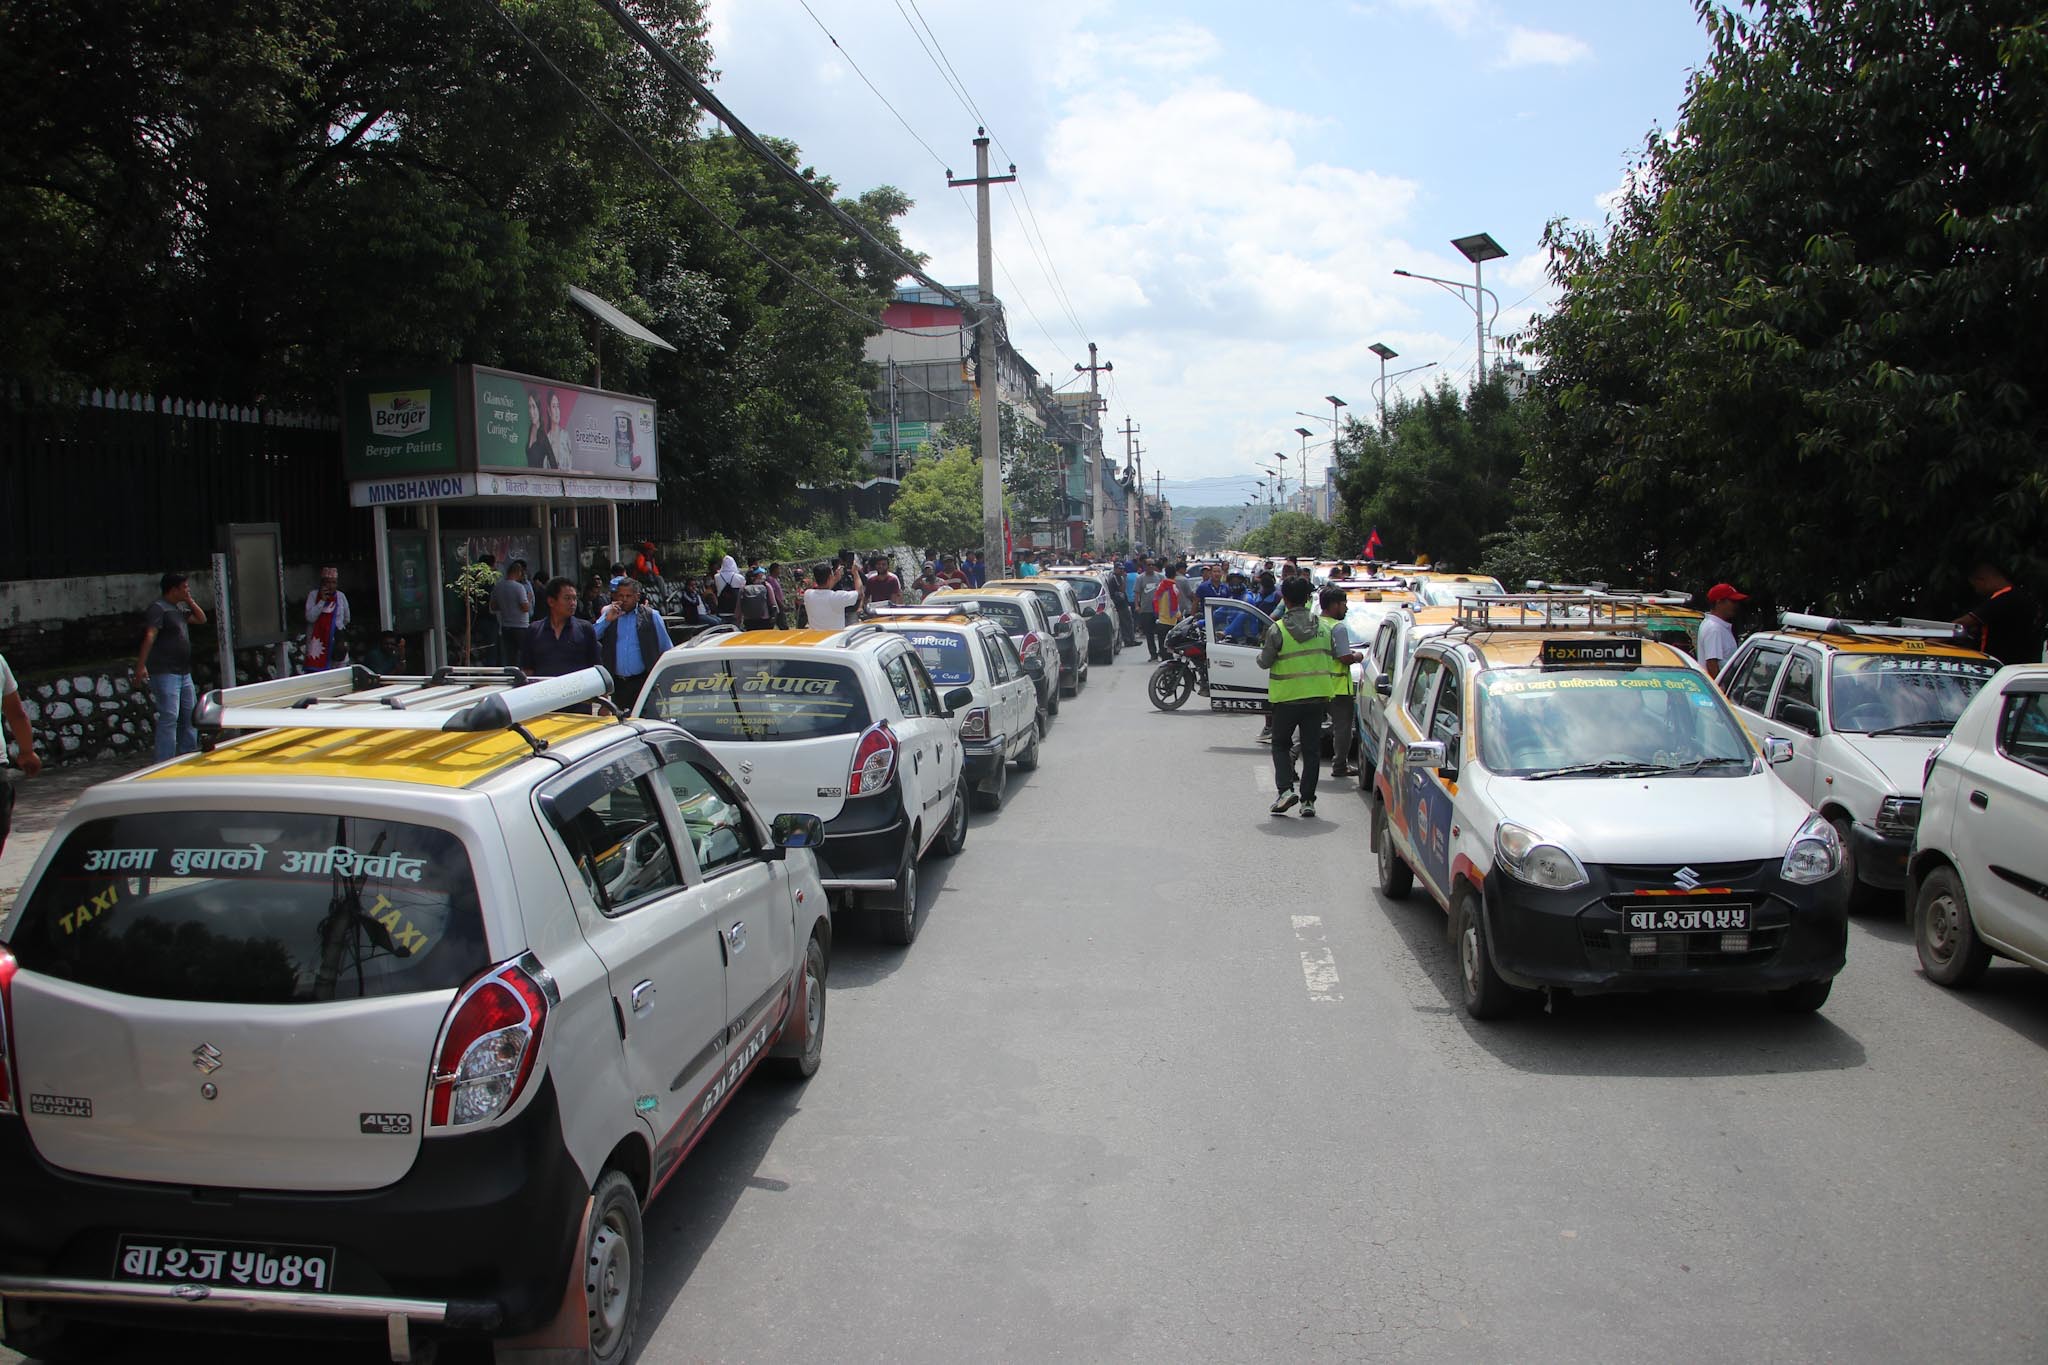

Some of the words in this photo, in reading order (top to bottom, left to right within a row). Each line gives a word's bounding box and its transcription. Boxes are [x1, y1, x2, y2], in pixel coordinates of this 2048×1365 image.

[376, 410, 426, 429] Berger
[487, 421, 508, 439] Caring
[366, 445, 402, 457] Berger
[406, 442, 442, 453] Paints
[369, 478, 463, 503] MINBHAWON
[1548, 645, 1636, 658] taximandu
[742, 671, 839, 694] नेपाल
[84, 848, 158, 871] आमा
[169, 844, 268, 875] बुबाको
[280, 846, 427, 882] आशिर्वाद
[58, 884, 119, 936] TAXI
[369, 894, 429, 954] TAXI
[32, 1095, 91, 1107] MARUTI
[32, 1104, 91, 1116] SUZUKI
[363, 1115, 410, 1125] ALTO
[382, 1125, 410, 1133] 800
[123, 1245, 228, 1280] बा.२ज
[231, 1251, 326, 1288] ५७४१
